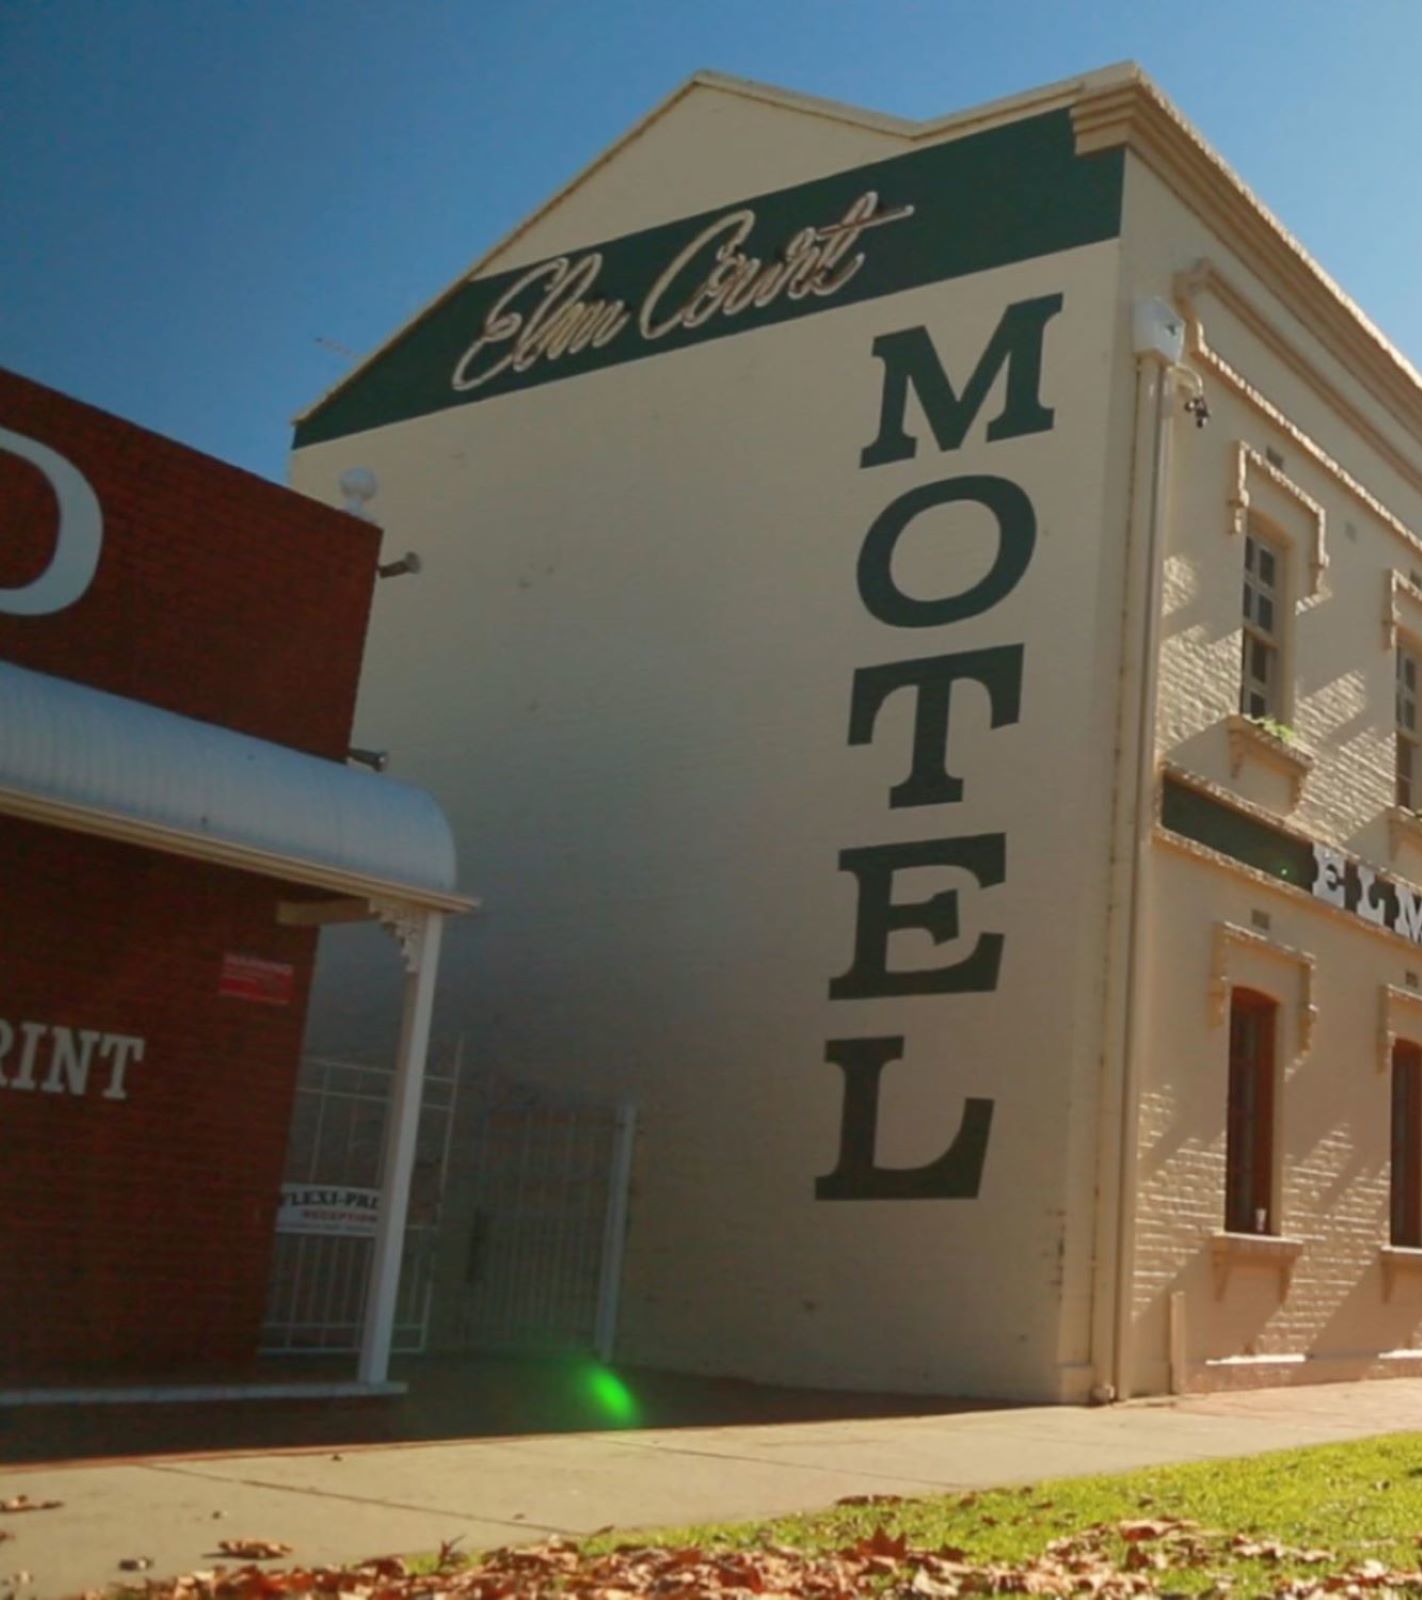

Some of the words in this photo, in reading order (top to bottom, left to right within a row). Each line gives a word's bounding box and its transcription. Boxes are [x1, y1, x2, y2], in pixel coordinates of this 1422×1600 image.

[452, 253, 632, 390] Elm
[640, 191, 915, 340] Court
[814, 292, 1064, 1201] MOTEL
